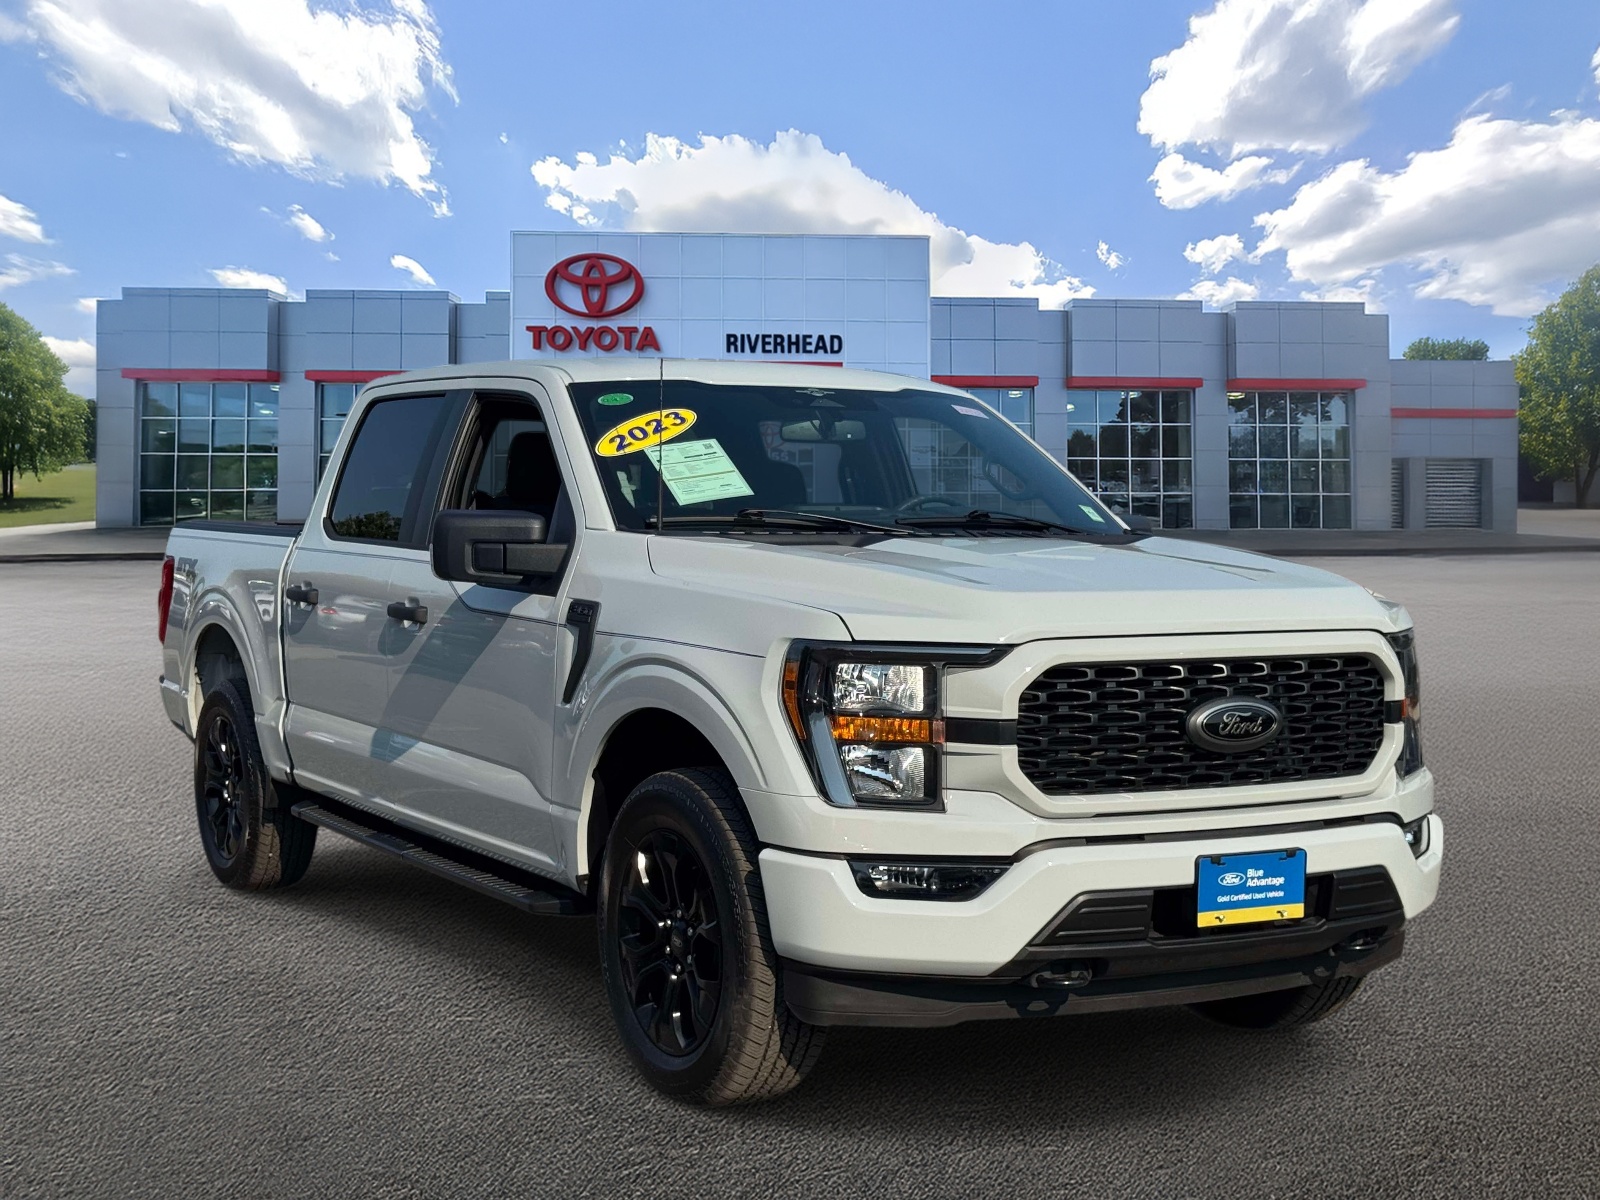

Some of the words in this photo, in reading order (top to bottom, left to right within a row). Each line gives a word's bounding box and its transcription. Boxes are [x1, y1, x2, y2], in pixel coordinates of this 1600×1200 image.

[525, 325, 661, 352] TOYOTA
[726, 333, 843, 354] RIVERHEAD
[608, 411, 687, 453] 2023
[1218, 711, 1263, 735] Ford
[1223, 874, 1241, 884] Ford
[1247, 868, 1264, 877] Blue
[1246, 877, 1285, 887] Advantage
[1231, 893, 1252, 901] Certified
[1253, 891, 1266, 899] Used
[1266, 890, 1284, 898] Vehicle
